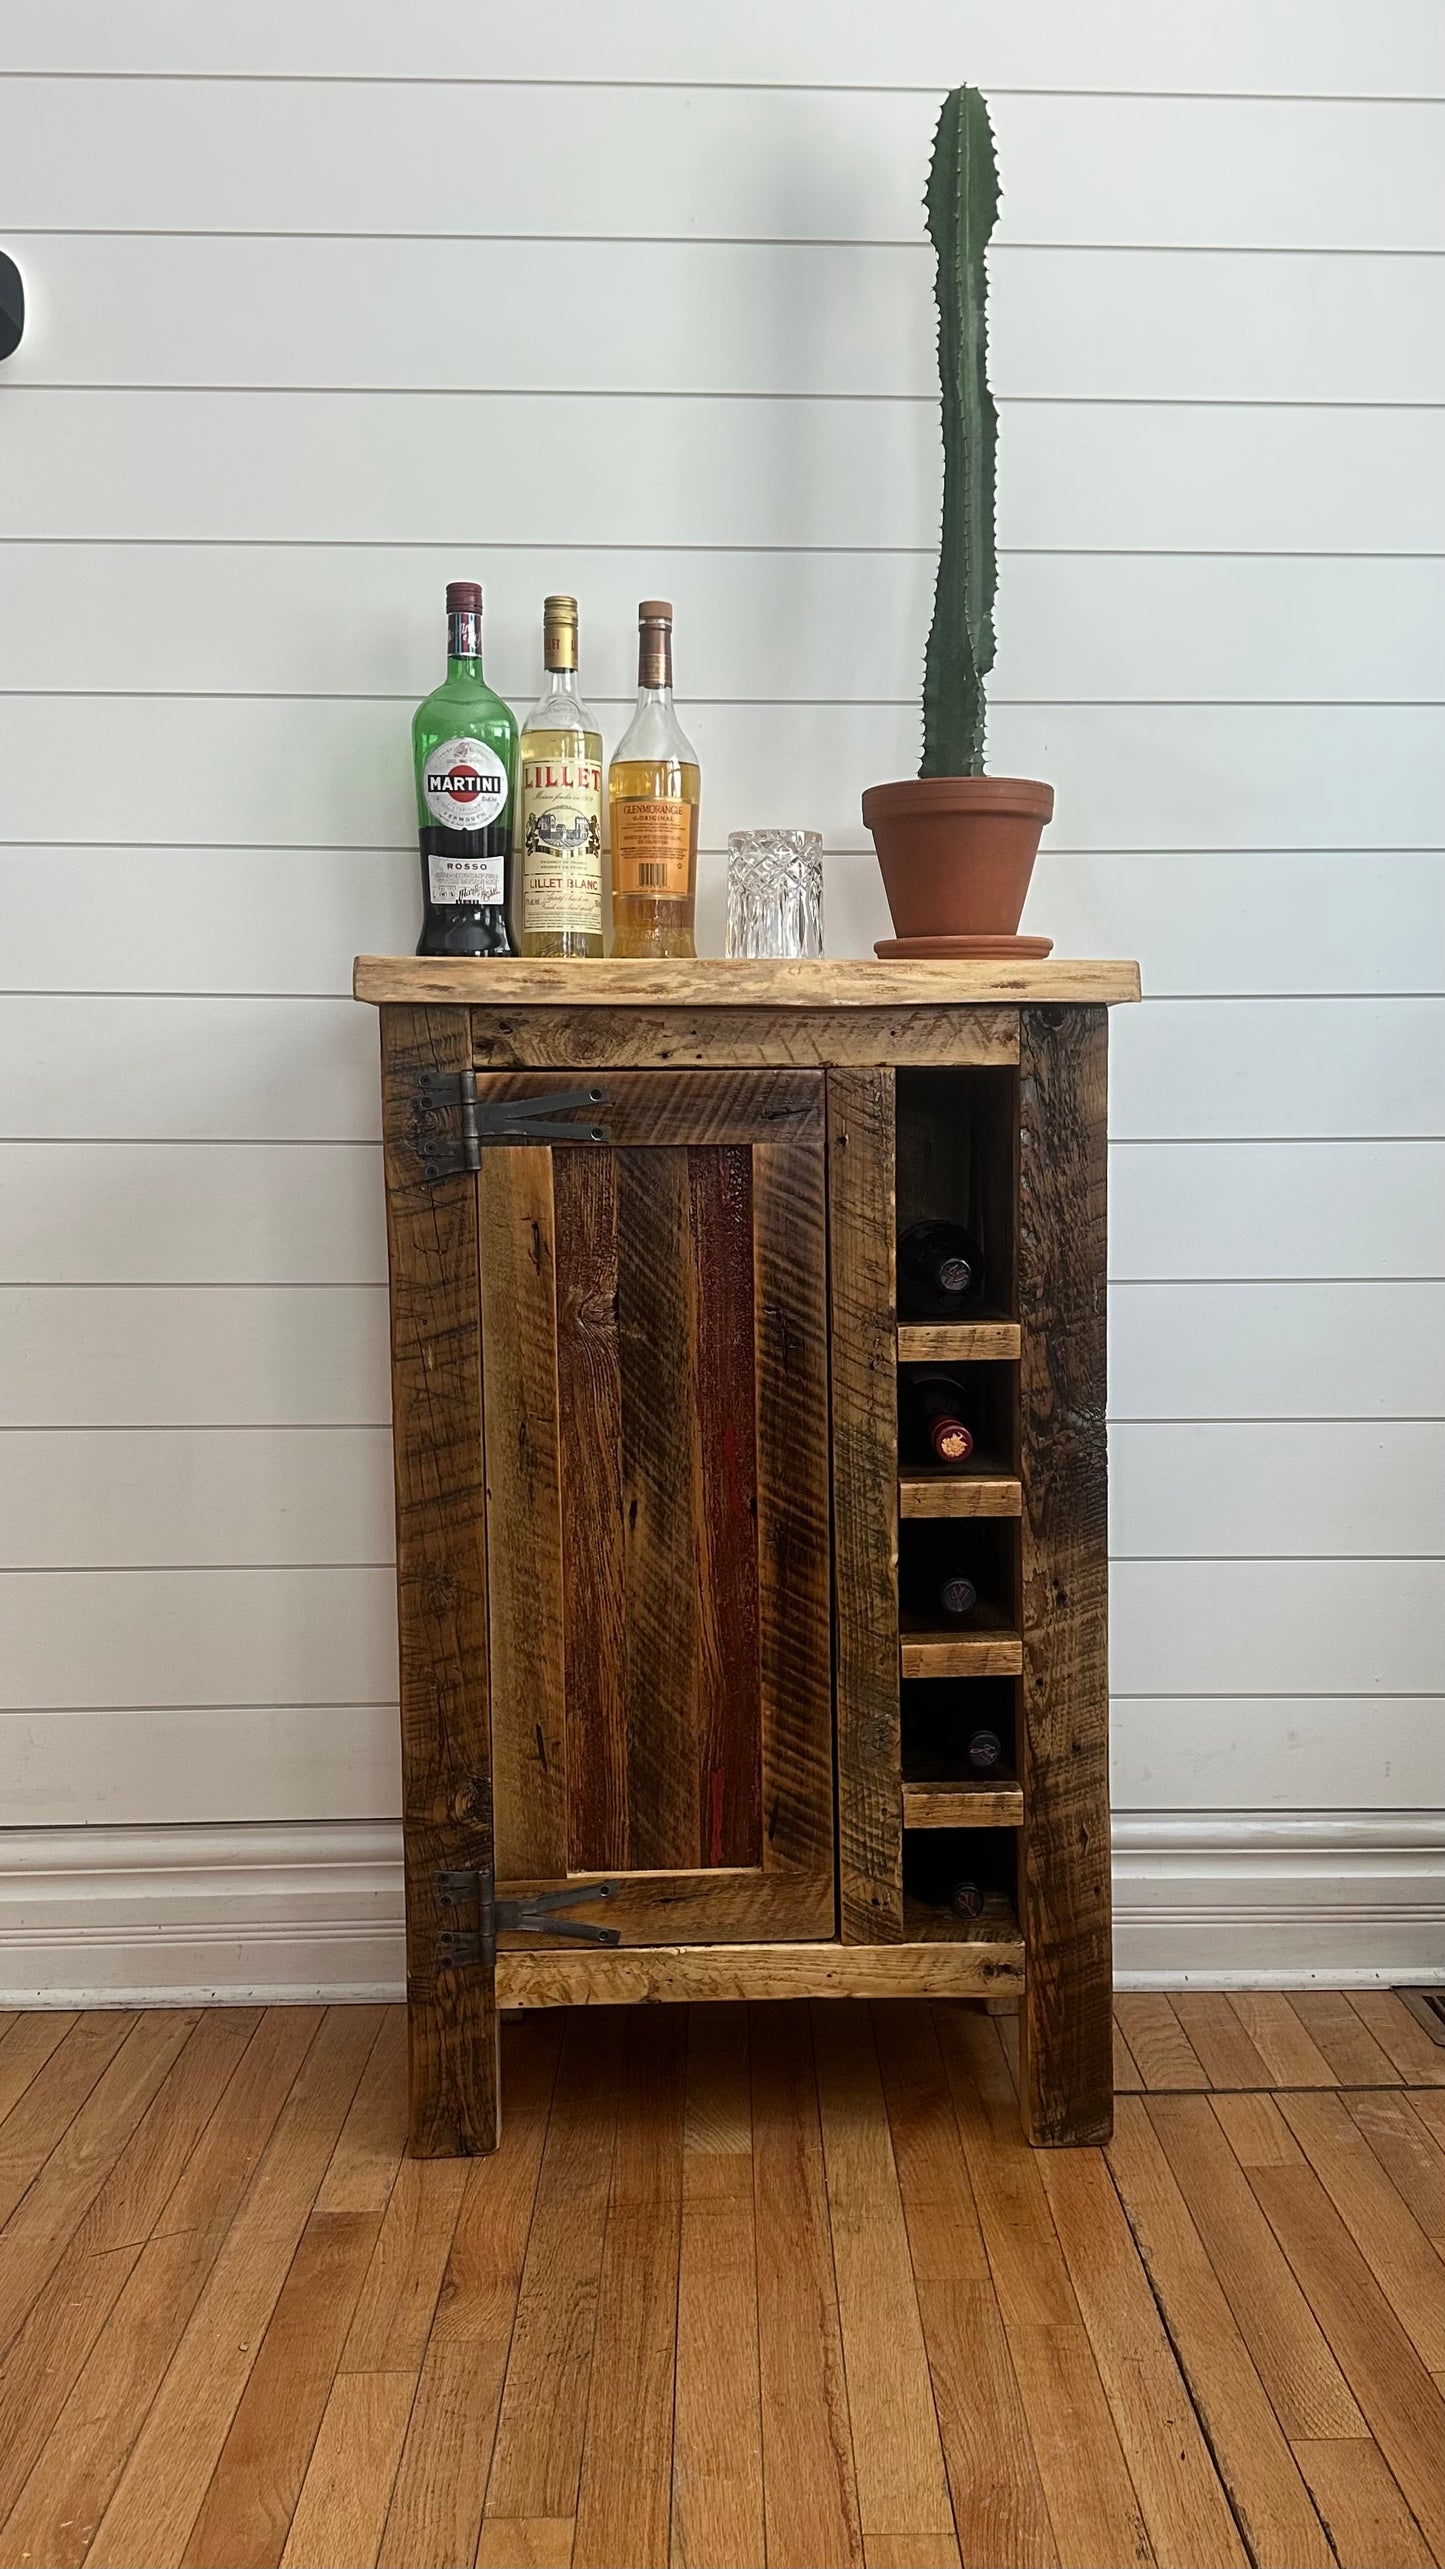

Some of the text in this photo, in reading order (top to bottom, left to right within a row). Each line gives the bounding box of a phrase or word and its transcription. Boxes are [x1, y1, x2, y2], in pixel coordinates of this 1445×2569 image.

[429, 776, 499, 792] MARTINI
[525, 766, 600, 792] LILLET
[623, 804, 683, 815] GLENMORANGIE
[446, 862, 488, 871] ROSSO
[530, 878, 598, 890] LILLET BLANC
